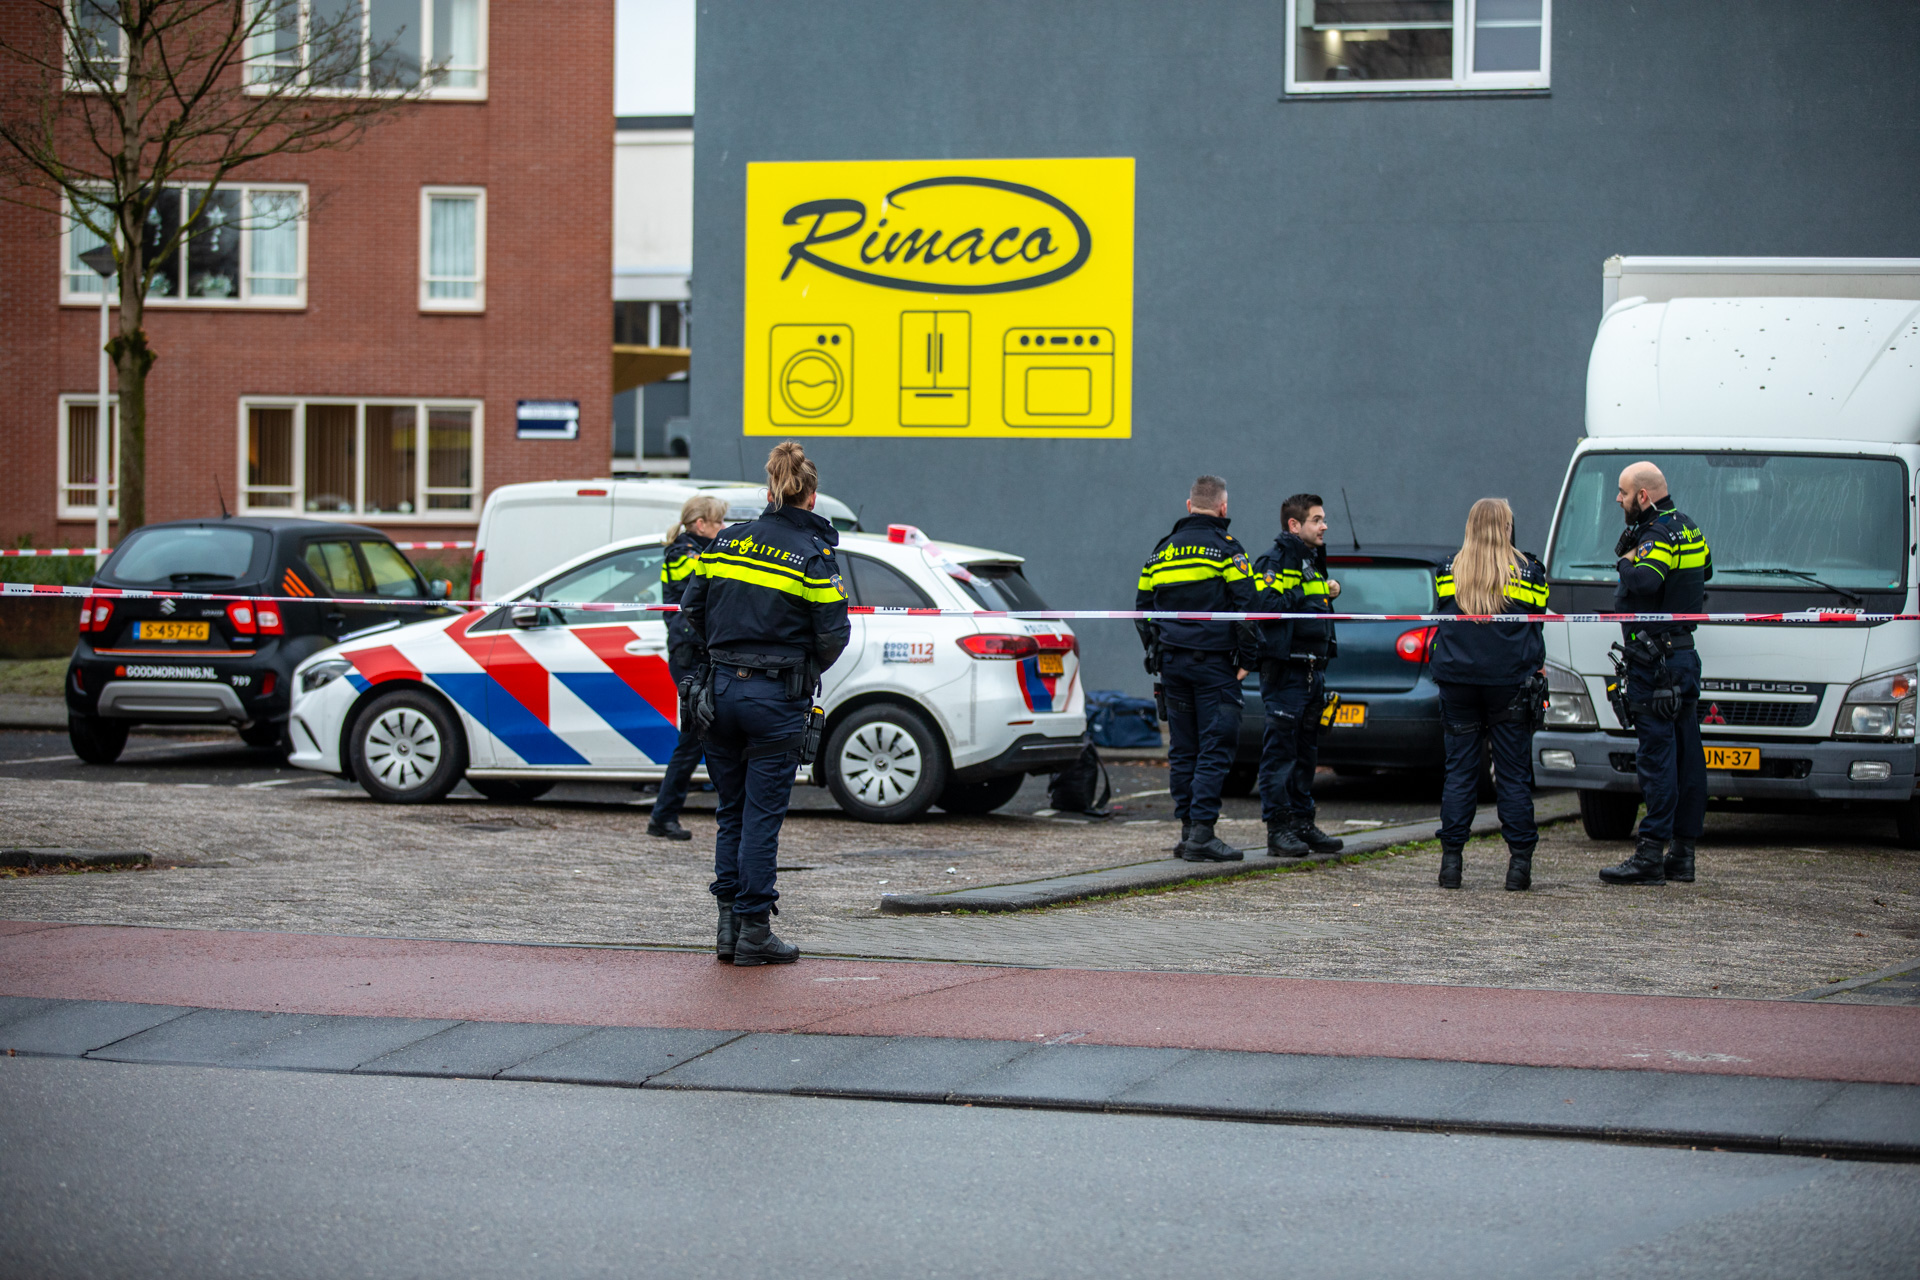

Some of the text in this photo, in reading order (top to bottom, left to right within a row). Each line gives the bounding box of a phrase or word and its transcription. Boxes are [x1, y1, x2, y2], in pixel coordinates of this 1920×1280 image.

[780, 196, 1062, 284] Rimaco
[730, 535, 791, 561] POLITIE
[1159, 542, 1206, 561] POLITIE
[145, 624, 204, 639] S-457-FG
[910, 642, 935, 656] 112
[126, 664, 218, 680] GOODMORNING.NL
[1747, 682, 1808, 694] FUSO
